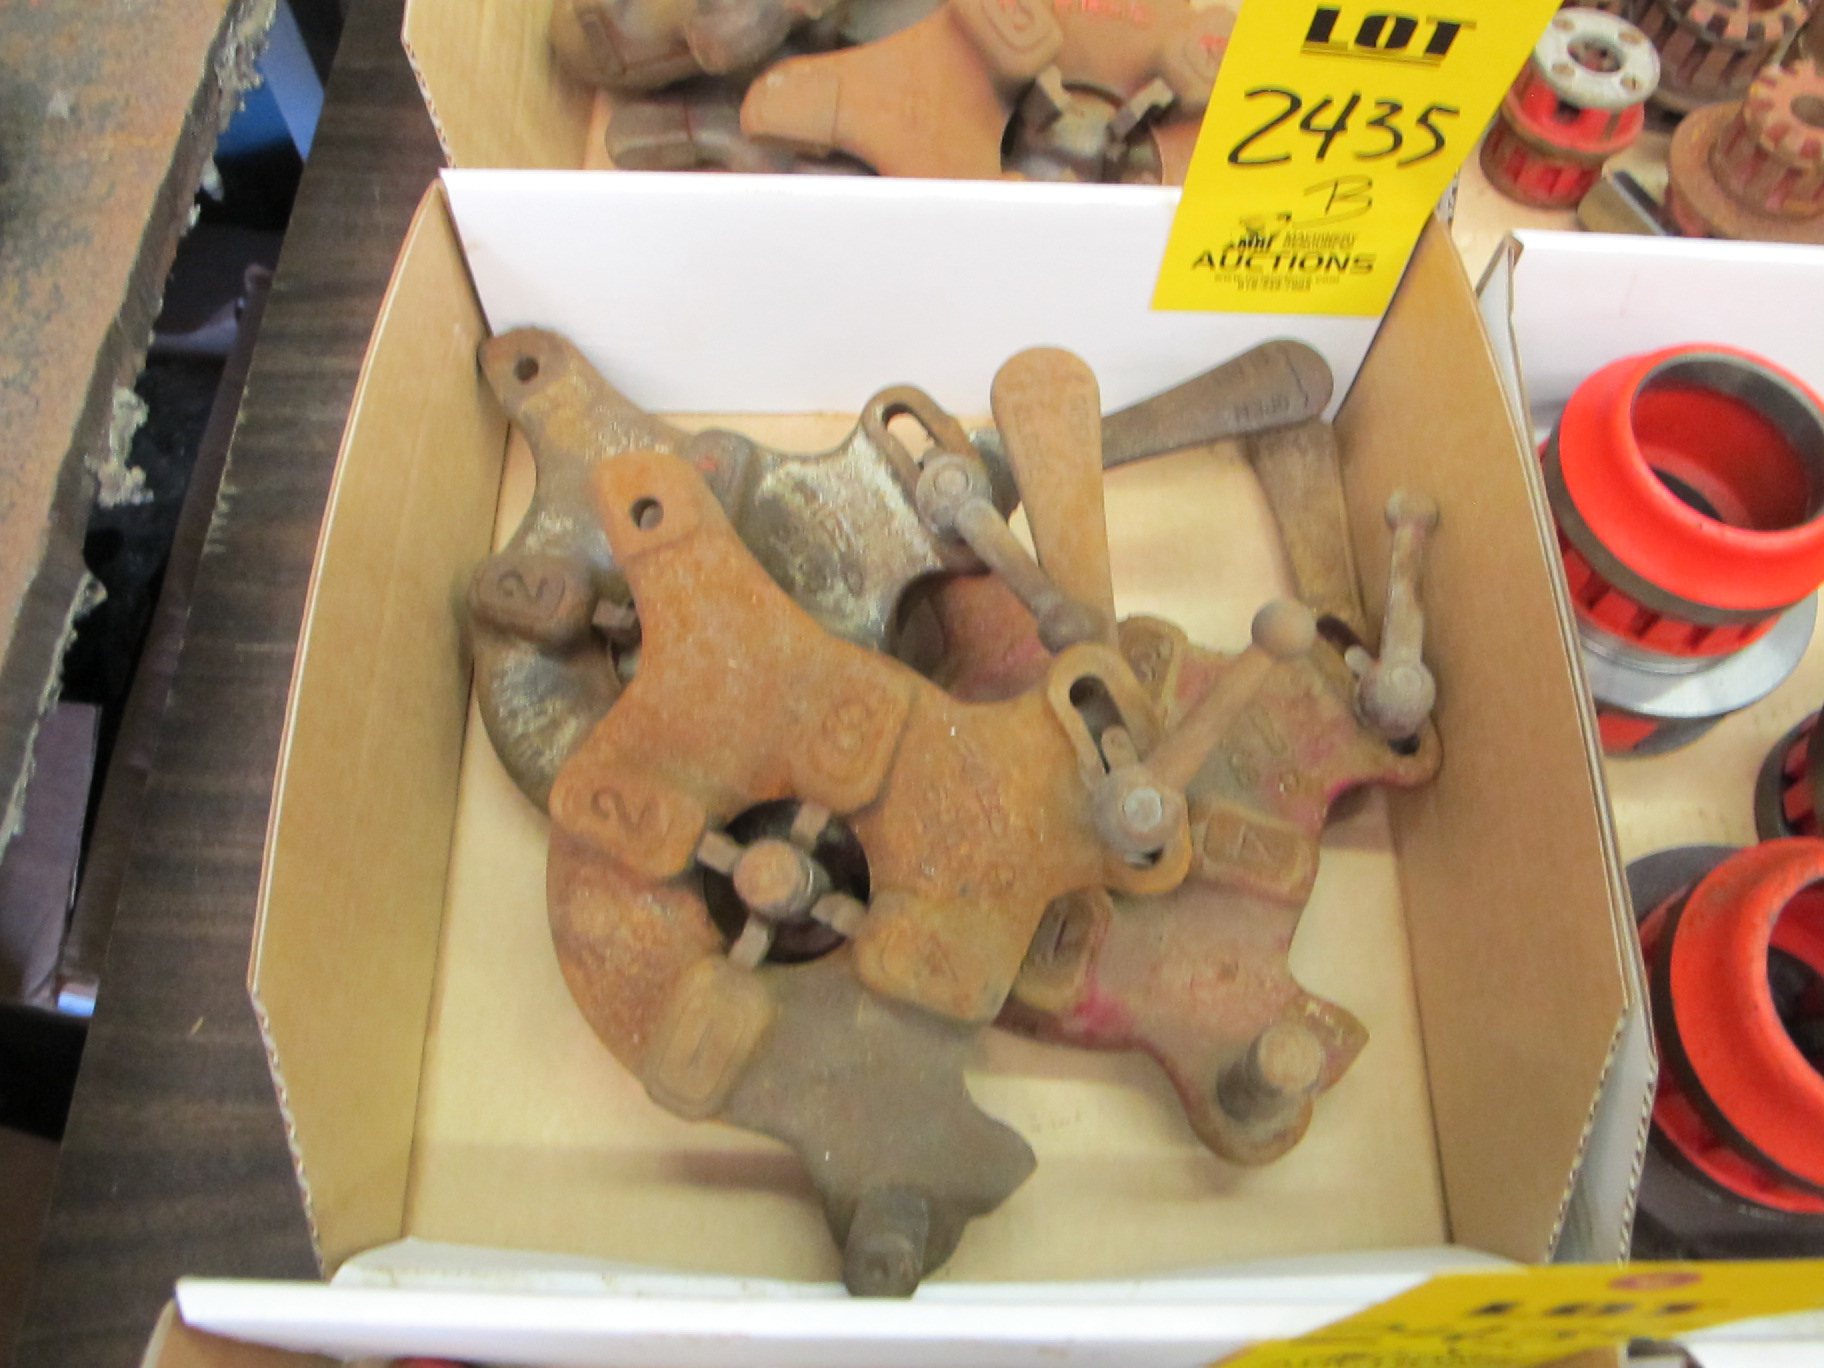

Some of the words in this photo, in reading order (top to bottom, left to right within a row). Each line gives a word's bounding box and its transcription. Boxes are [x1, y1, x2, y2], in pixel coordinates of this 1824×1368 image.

[1301, 4, 1477, 67] LOT
[1227, 86, 1461, 169] 2435
[1293, 174, 1374, 228] B
[1191, 248, 1377, 274] AUCTIONS
